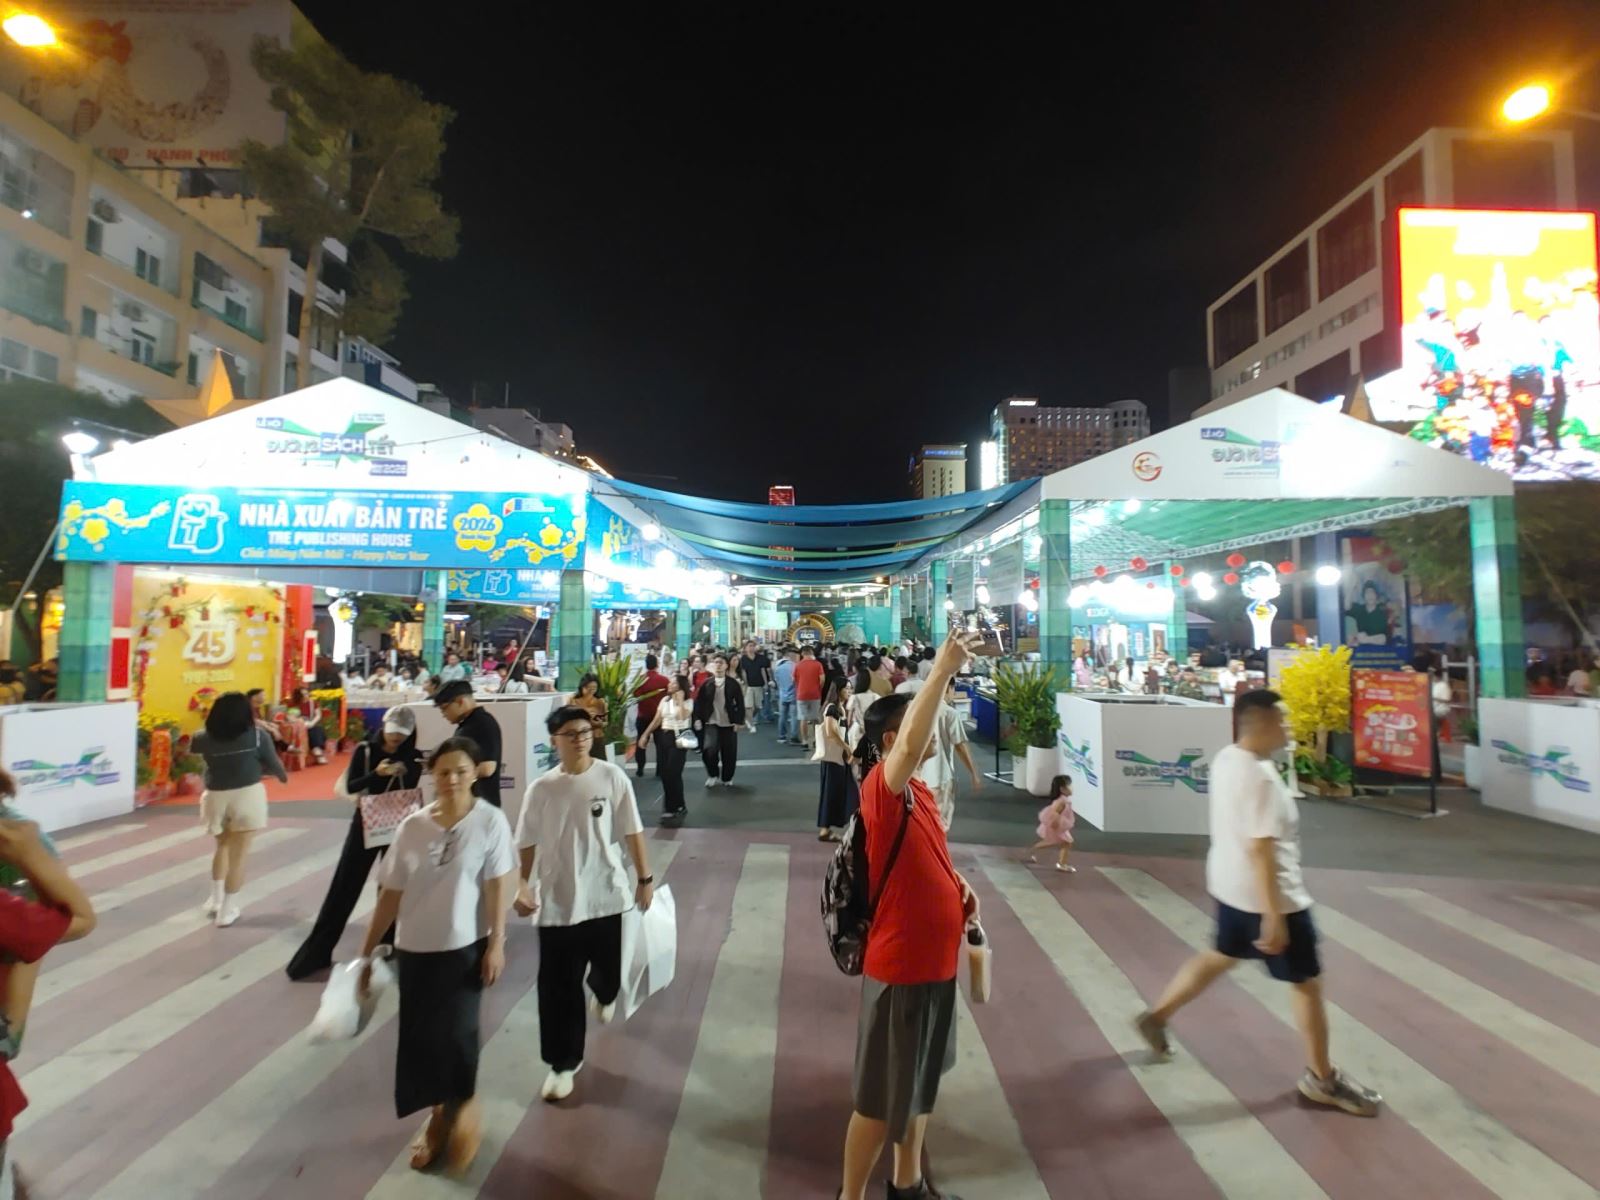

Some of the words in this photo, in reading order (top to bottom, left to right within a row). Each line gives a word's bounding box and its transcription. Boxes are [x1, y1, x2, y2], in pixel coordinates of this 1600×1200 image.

[239, 500, 289, 527] NHÀ
[292, 498, 352, 528] XUẤT
[355, 500, 402, 529] BẢN
[406, 502, 448, 530] TRẺ
[460, 517, 496, 531] 2026
[294, 531, 368, 547] PUBLISHING
[371, 533, 413, 547] HOUSE
[192, 630, 226, 658] 45
